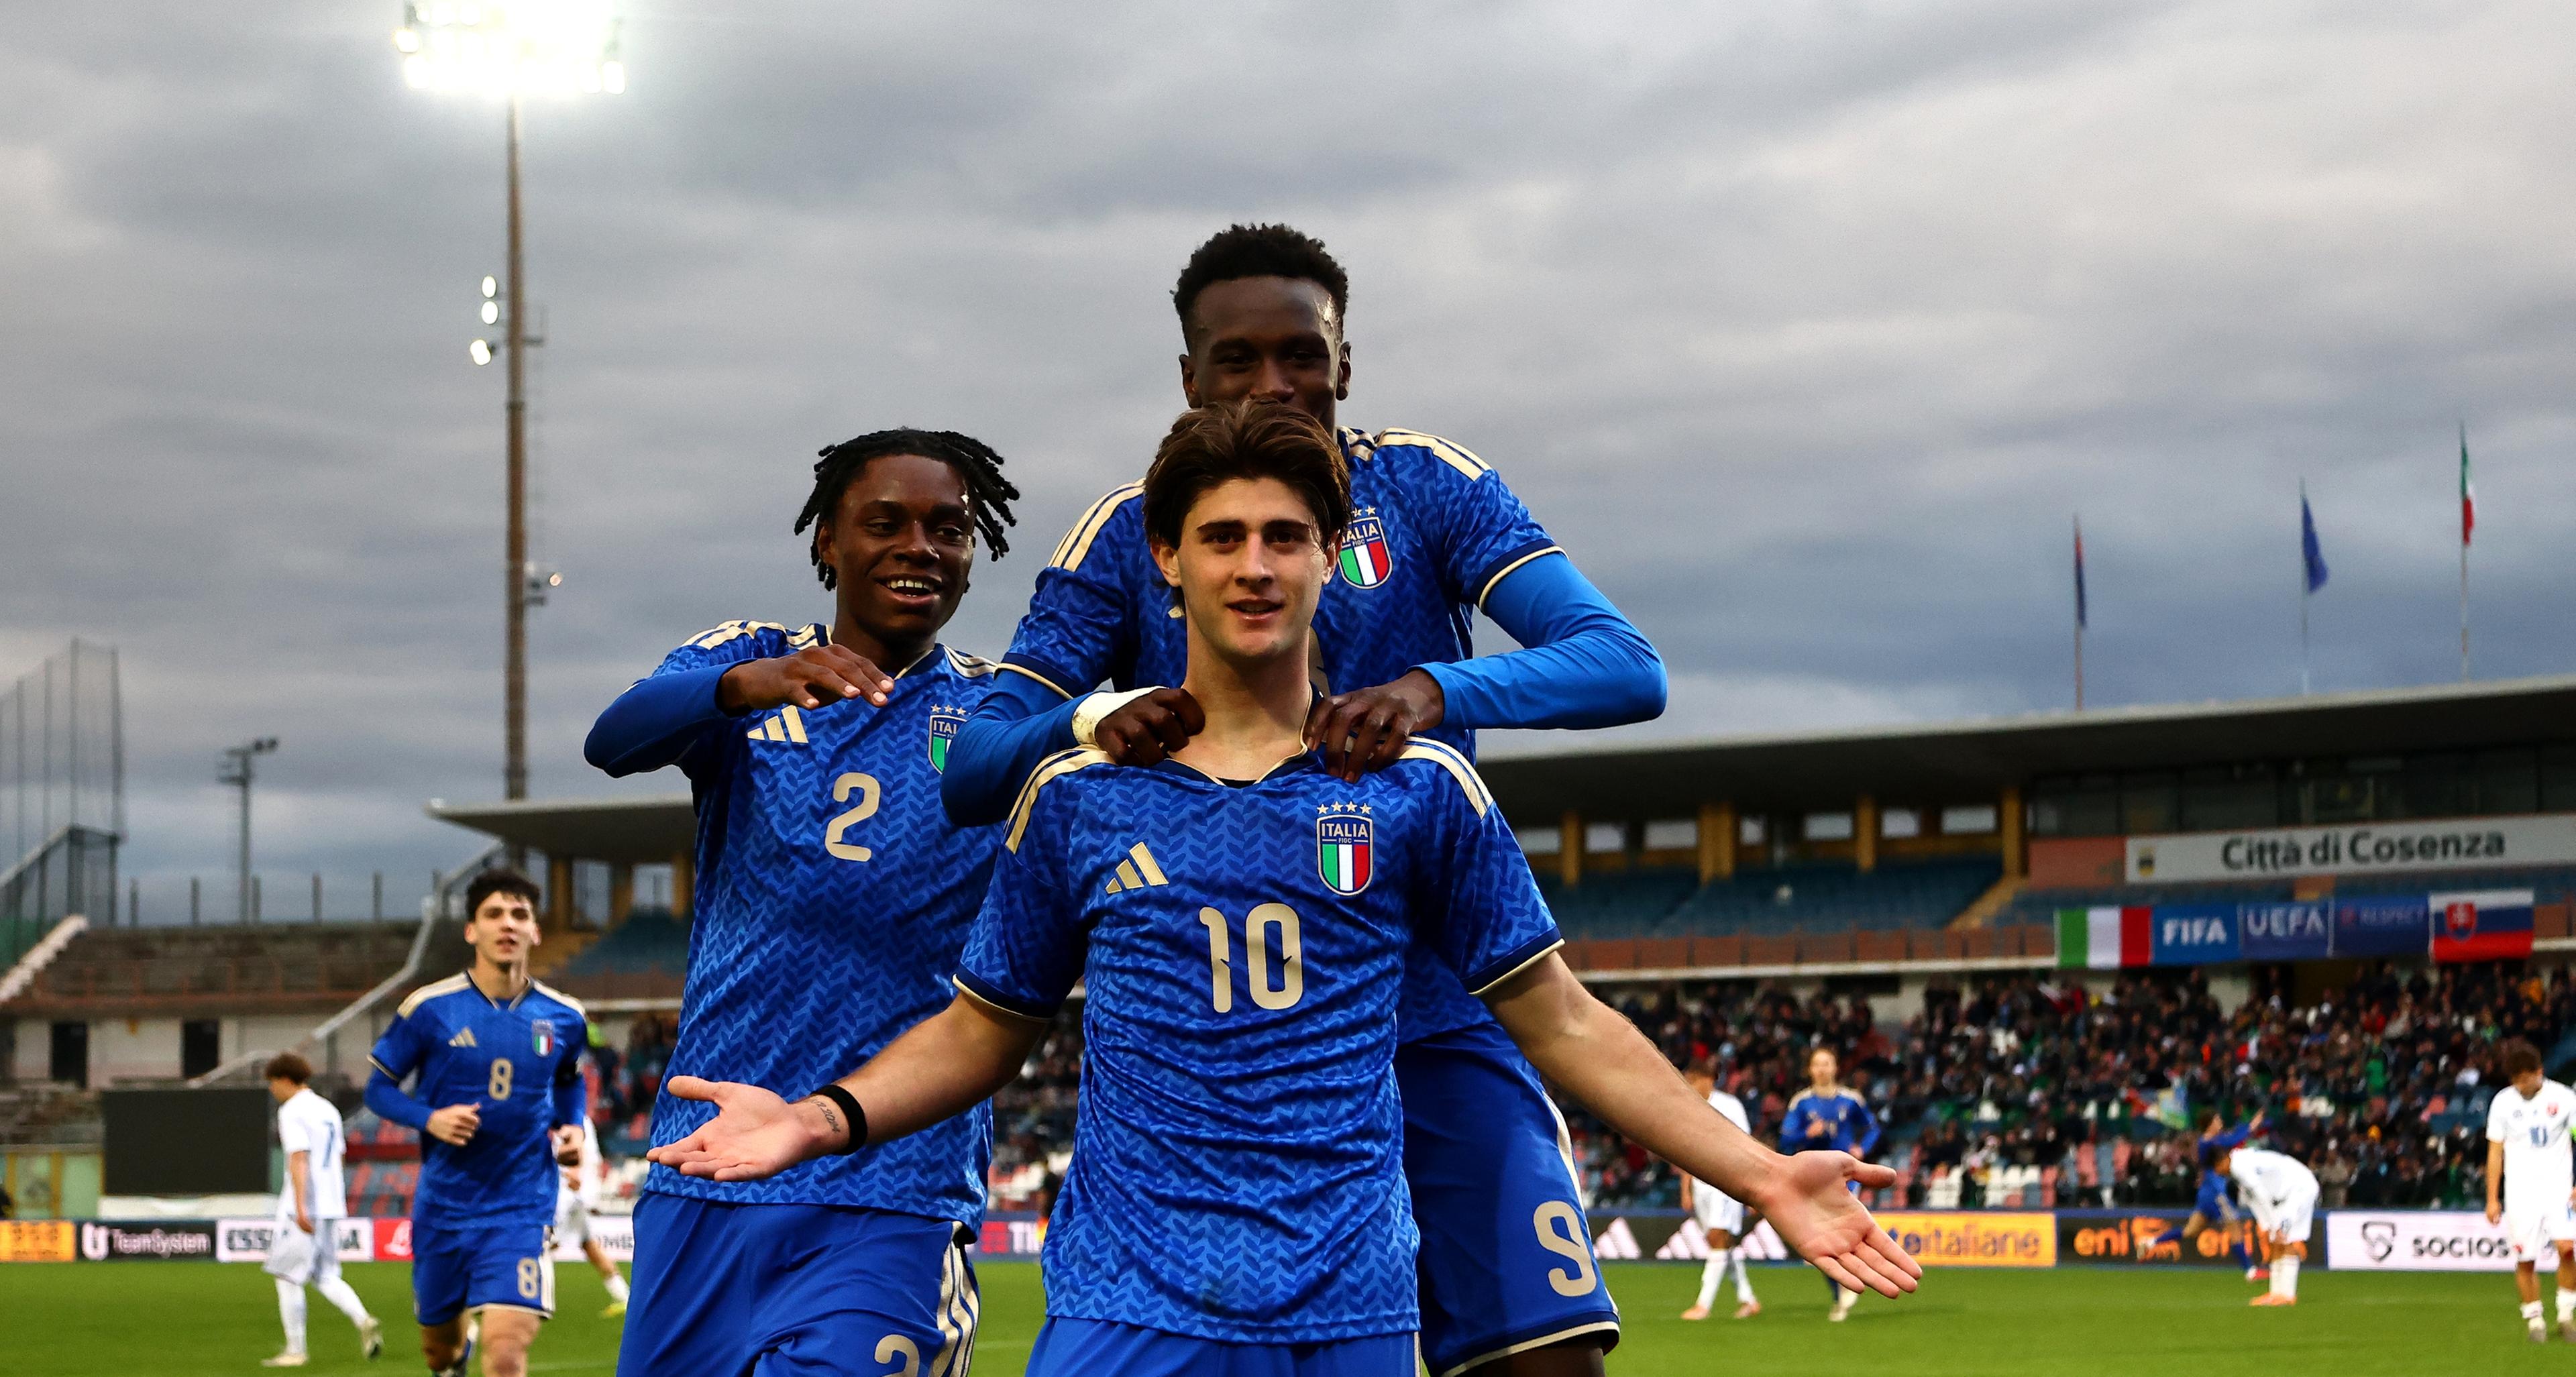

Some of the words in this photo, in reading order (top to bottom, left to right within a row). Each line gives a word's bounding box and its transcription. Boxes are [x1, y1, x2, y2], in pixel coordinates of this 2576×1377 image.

[824, 772, 881, 863] 2
[1322, 823, 1368, 838] ITALIA
[2221, 836, 2302, 871] Città
[2309, 832, 2342, 866] di
[2349, 829, 2506, 865] Cosenza
[2163, 917, 2227, 946] FIFA
[2247, 907, 2326, 936] UEFA
[1199, 902, 1303, 1013] 10
[488, 1058, 514, 1101] 8
[110, 1228, 211, 1258] TeamSystem
[1534, 1200, 1597, 1297] 9
[2074, 1219, 2129, 1257] eni
[517, 1257, 539, 1299] 8
